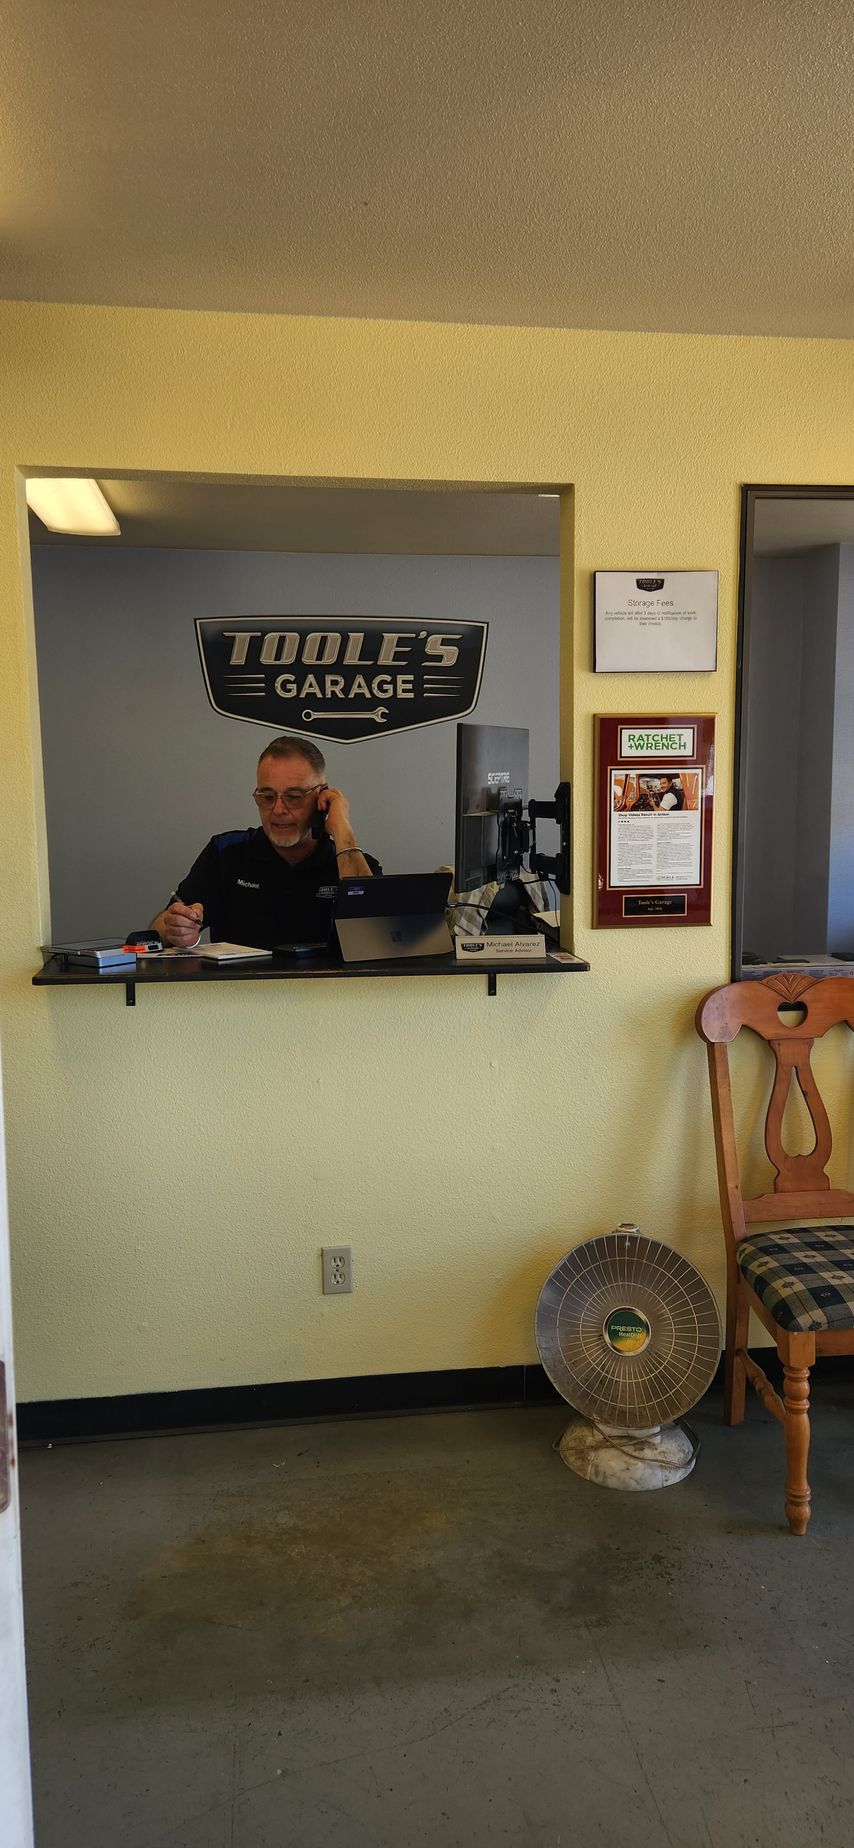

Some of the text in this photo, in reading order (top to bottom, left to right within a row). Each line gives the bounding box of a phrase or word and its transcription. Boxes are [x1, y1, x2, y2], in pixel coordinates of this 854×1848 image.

[222, 631, 464, 667] TOOLE'S
[274, 674, 415, 699] GARAGE
[628, 734, 684, 743] RATCHET
[628, 742, 687, 751] +WRENCH
[236, 879, 260, 889] Michael
